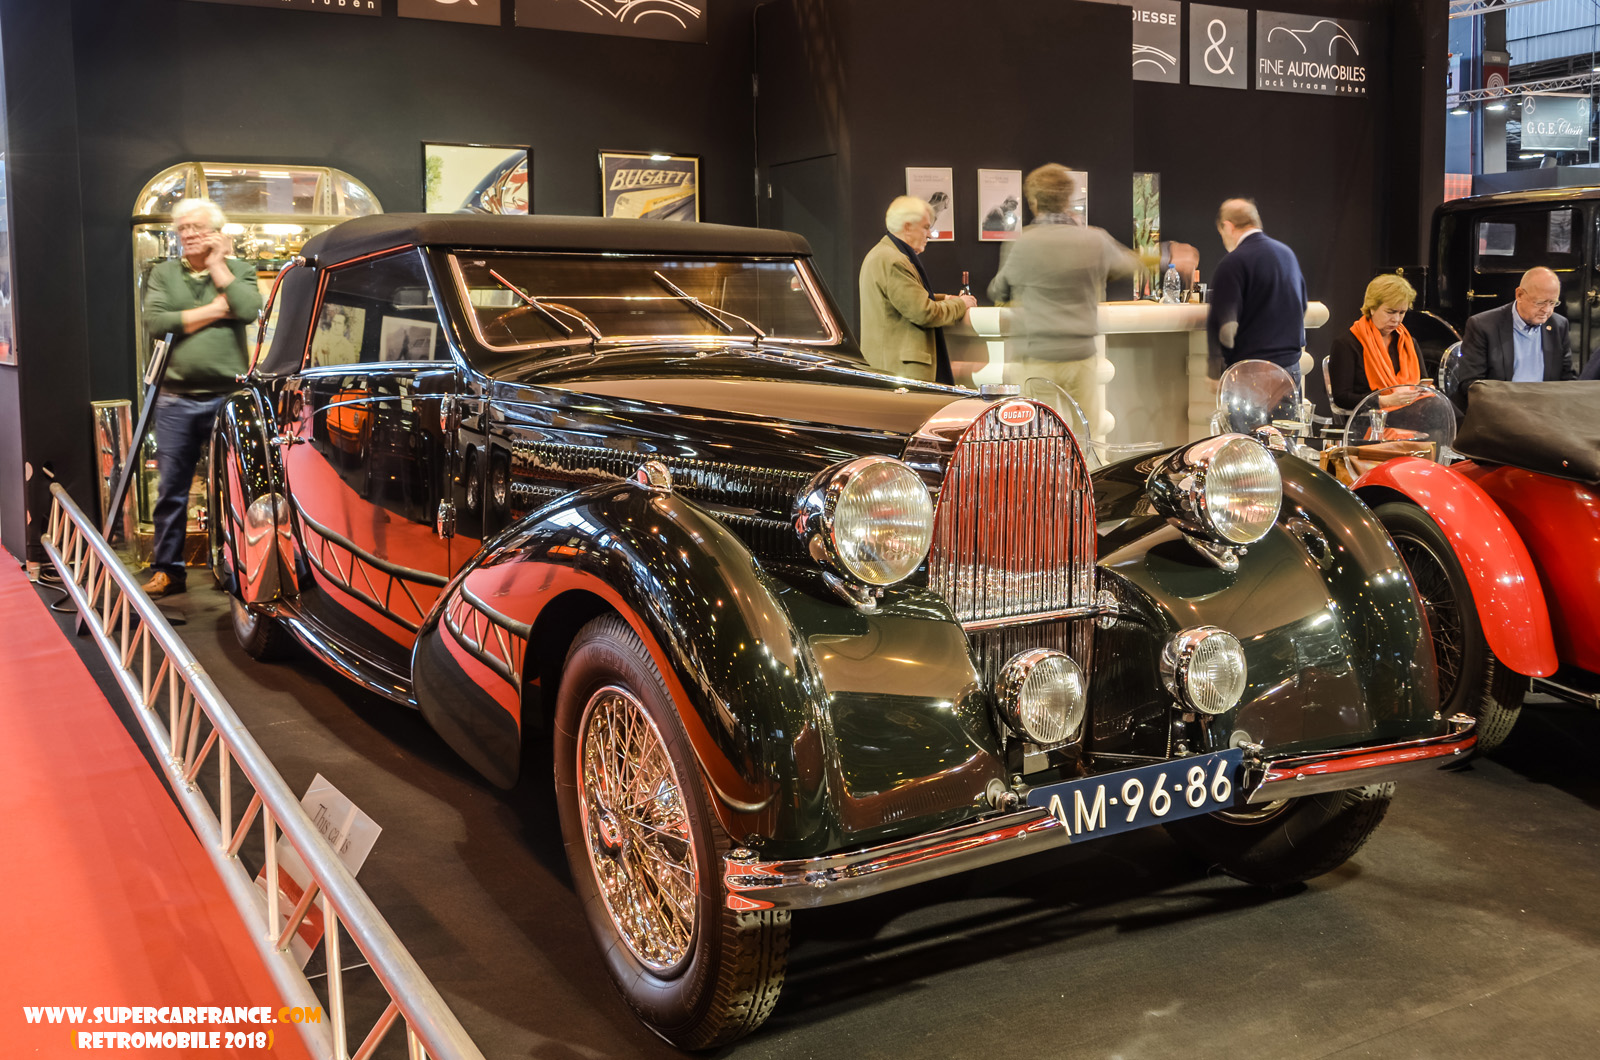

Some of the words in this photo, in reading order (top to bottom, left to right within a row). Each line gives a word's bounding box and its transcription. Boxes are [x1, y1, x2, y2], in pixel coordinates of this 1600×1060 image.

[1259, 58, 1284, 76] FINE
[1287, 61, 1366, 82] AUTOMOBILES
[1259, 77, 1284, 88] jack
[1292, 79, 1327, 91] braam
[1334, 83, 1366, 94] ruben
[1526, 121, 1557, 135] G.G.E.
[609, 168, 693, 191] BUGATTI
[1003, 410, 1032, 419] BUGATTI
[1050, 759, 1232, 837] AM-96-86
[312, 803, 331, 835] This
[340, 833, 352, 855] is
